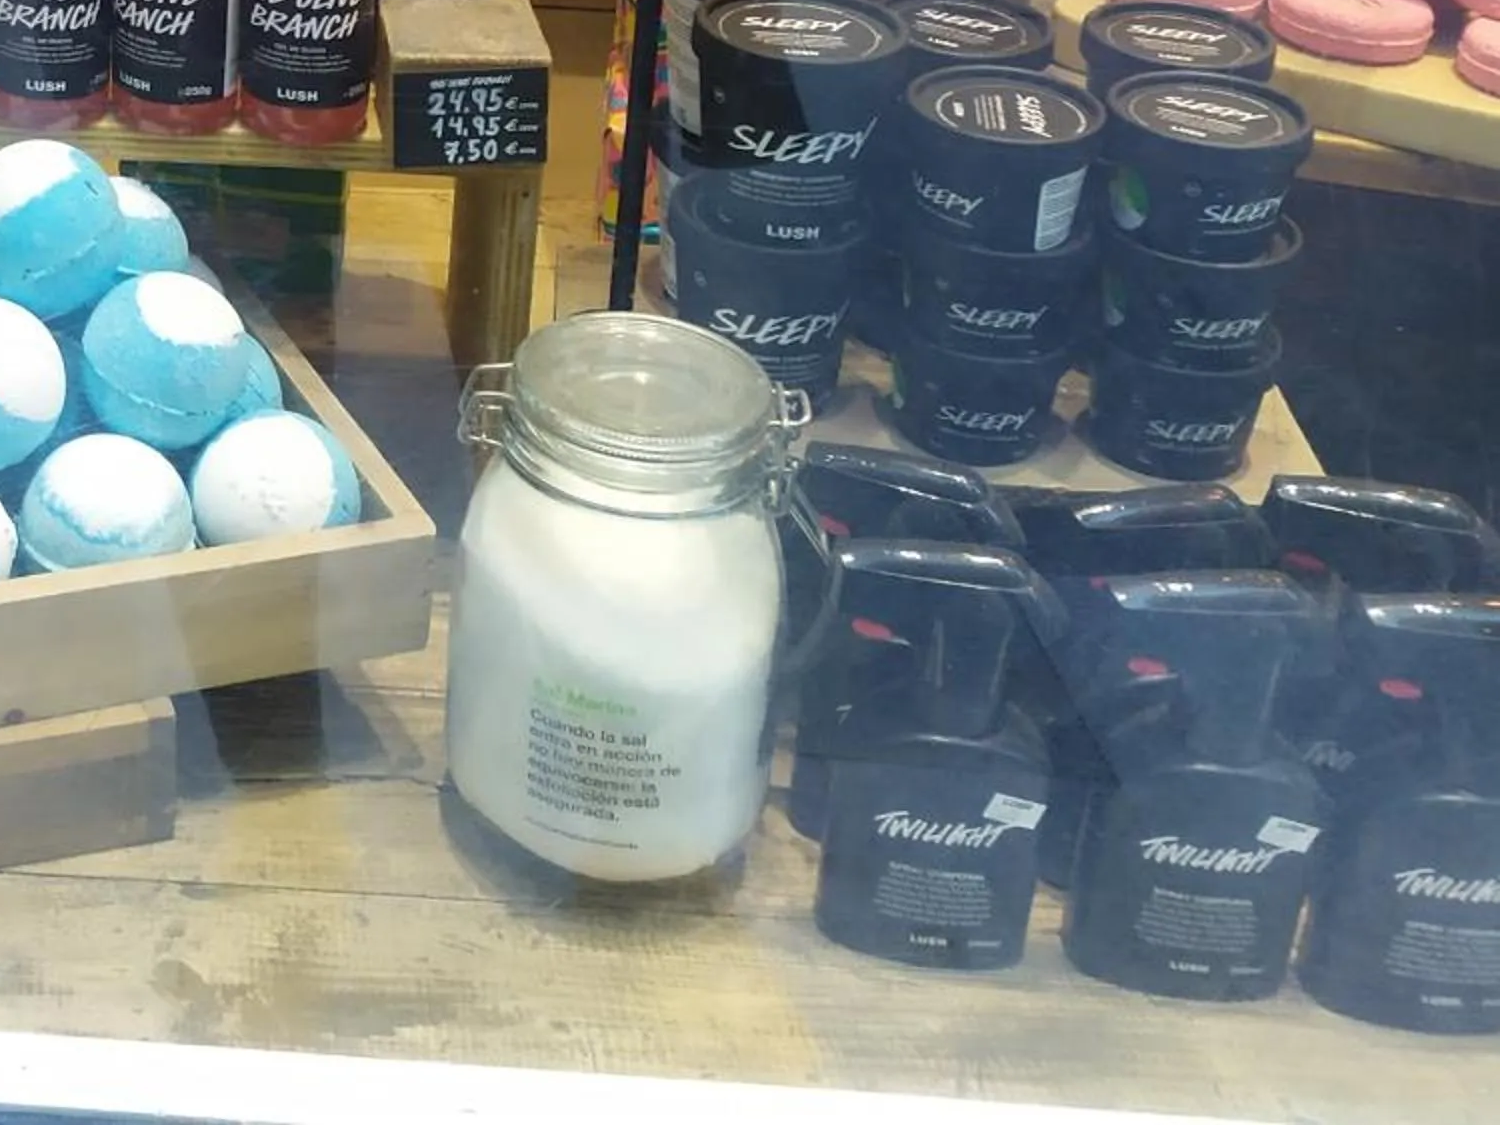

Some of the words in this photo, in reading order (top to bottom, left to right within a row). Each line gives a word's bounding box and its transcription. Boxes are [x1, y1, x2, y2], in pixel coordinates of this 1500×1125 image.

[250, 2, 359, 41] BRANCH
[740, 16, 852, 32] SLEEPY
[916, 7, 1013, 34] SLEEPY
[1126, 23, 1227, 44] SLEEPY
[25, 79, 67, 92] LUSH
[119, 72, 150, 91] LUSH
[277, 87, 319, 101] LUSH
[1156, 94, 1269, 122] SLEEPY
[727, 112, 882, 165] SLEEPY
[766, 223, 820, 239] LUSH
[708, 298, 850, 346] SLEEPY
[945, 301, 1049, 331] SLEEPY
[1168, 314, 1269, 340] SLEEPY
[934, 408, 1037, 432] SLEEPY
[1145, 415, 1246, 442] SLEEPY
[601, 730, 615, 744] la
[576, 743, 598, 757] en
[660, 765, 682, 778] de
[874, 810, 1013, 849] TWILIGHT
[1140, 836, 1287, 873] TWILIGHT
